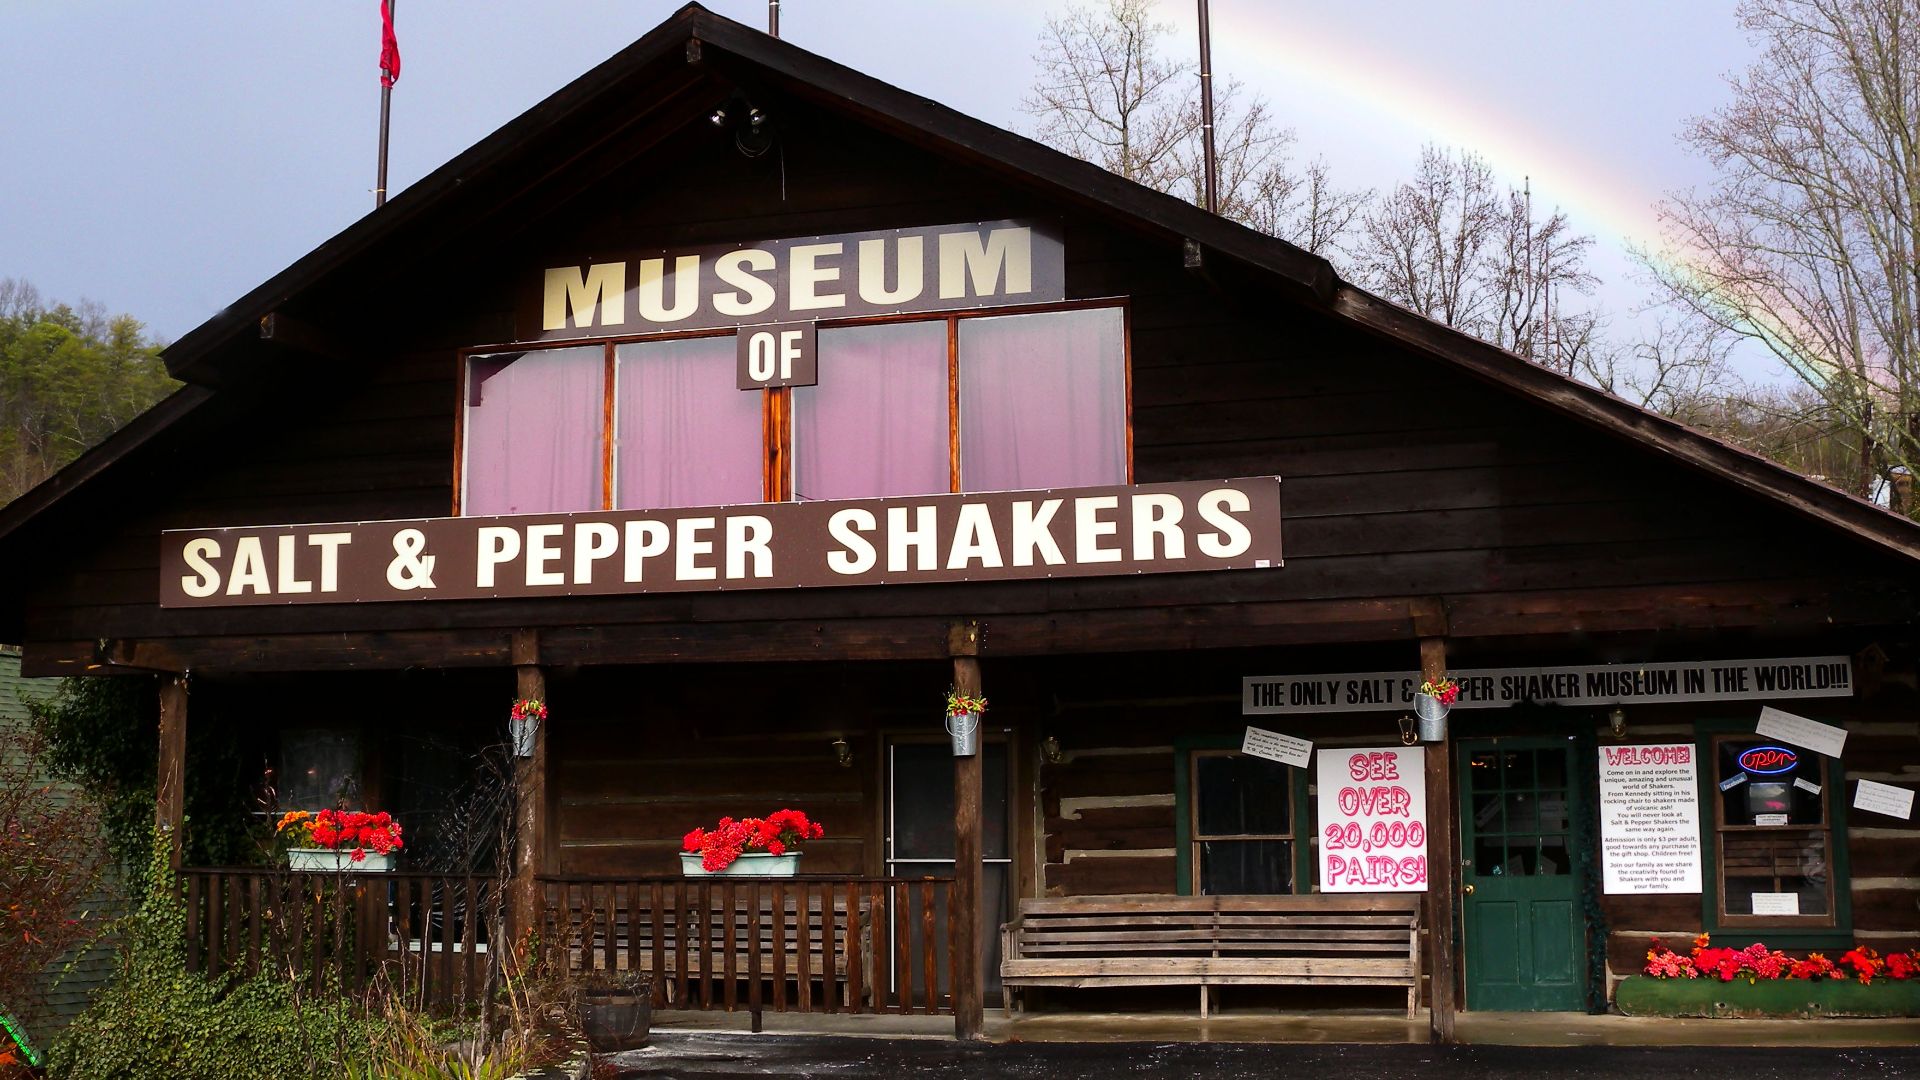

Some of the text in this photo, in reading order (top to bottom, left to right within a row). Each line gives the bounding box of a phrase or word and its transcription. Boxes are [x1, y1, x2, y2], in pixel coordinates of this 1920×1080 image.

[542, 227, 1031, 331] MUSEUM
[748, 330, 802, 382] OF
[181, 488, 1252, 598] SALT & PEPPER SHAKERS
[1252, 682, 1284, 706] THE
[1290, 680, 1340, 706] ONLY
[1347, 679, 1395, 704] SALT
[1401, 678, 1415, 702] &
[1501, 672, 1580, 699] SHAKER
[1587, 669, 1677, 697] MUSEUM
[1684, 669, 1705, 694] IN
[1711, 667, 1748, 692] THE
[1755, 663, 1848, 692] WORLD!!!
[1349, 752, 1399, 781] SEE
[1605, 746, 1691, 766] WELCOME!
[1338, 786, 1411, 818] OVER
[1325, 821, 1424, 853] 20,000
[1327, 855, 1426, 887] PAIRS!
